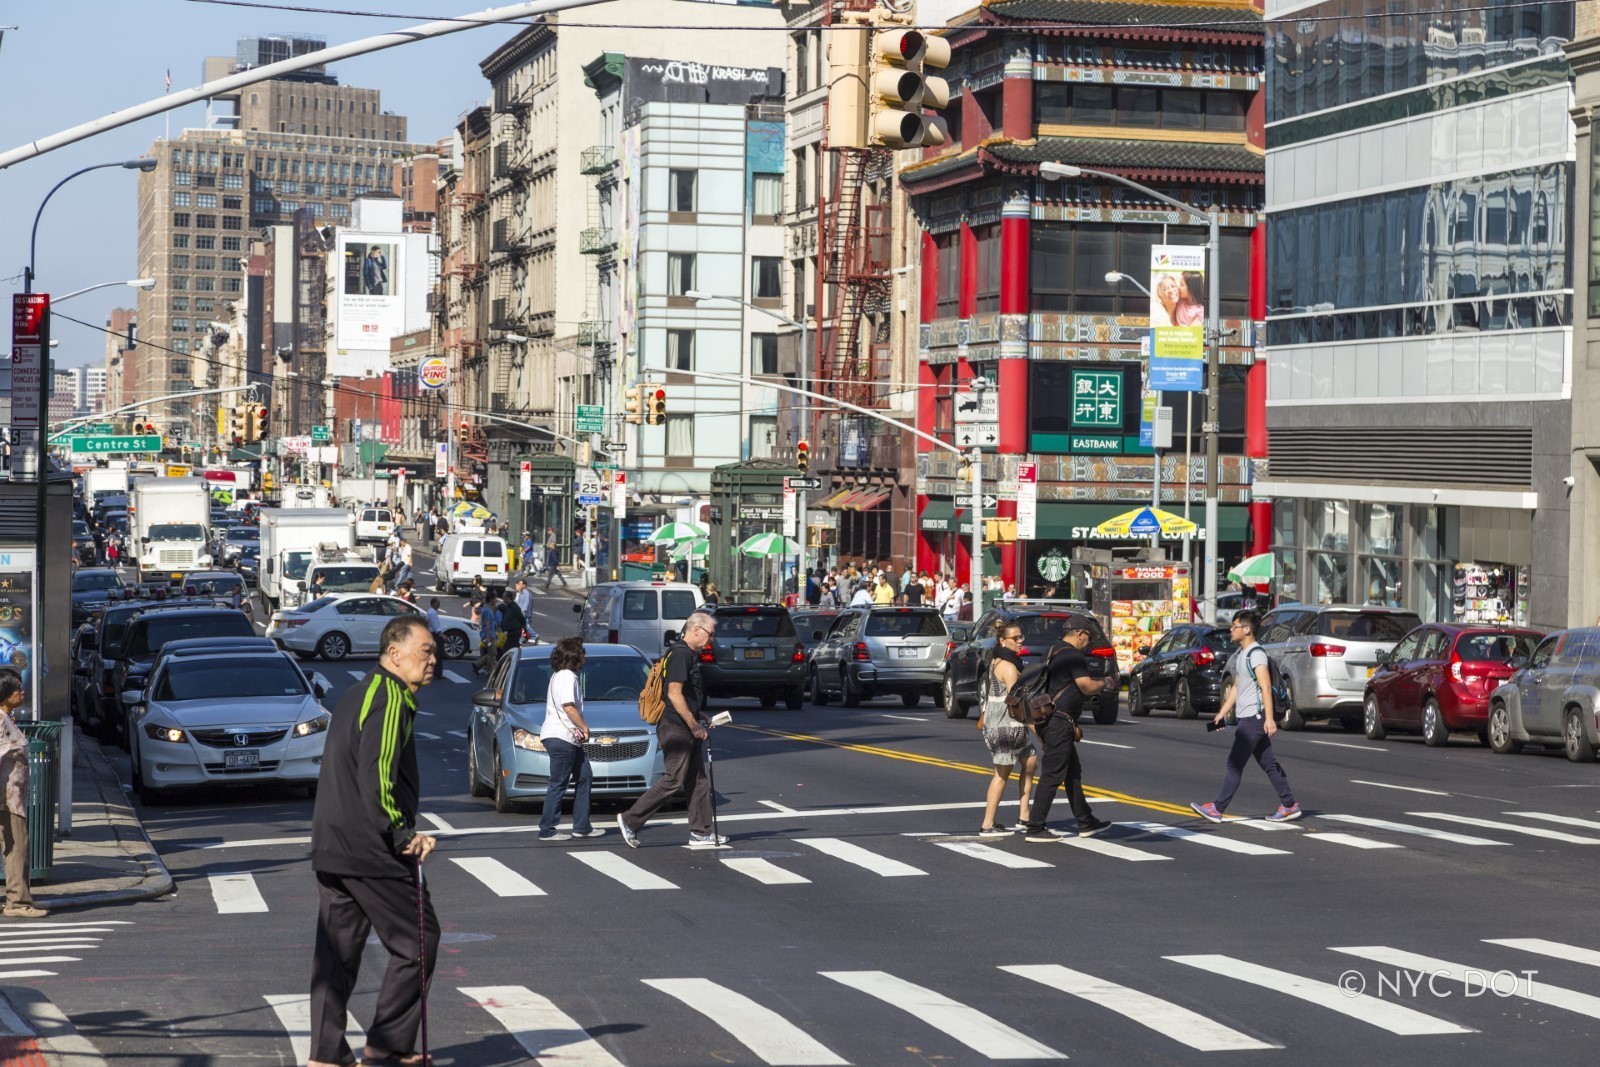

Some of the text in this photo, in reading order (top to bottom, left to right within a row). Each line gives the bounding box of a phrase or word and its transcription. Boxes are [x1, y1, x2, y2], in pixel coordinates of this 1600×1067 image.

[14, 348, 20, 362] 3
[12, 430, 18, 444] 5
[86, 440, 146, 450] Centre St
[1073, 439, 1118, 448] EASTBANK
[582, 484, 598, 493] 25
